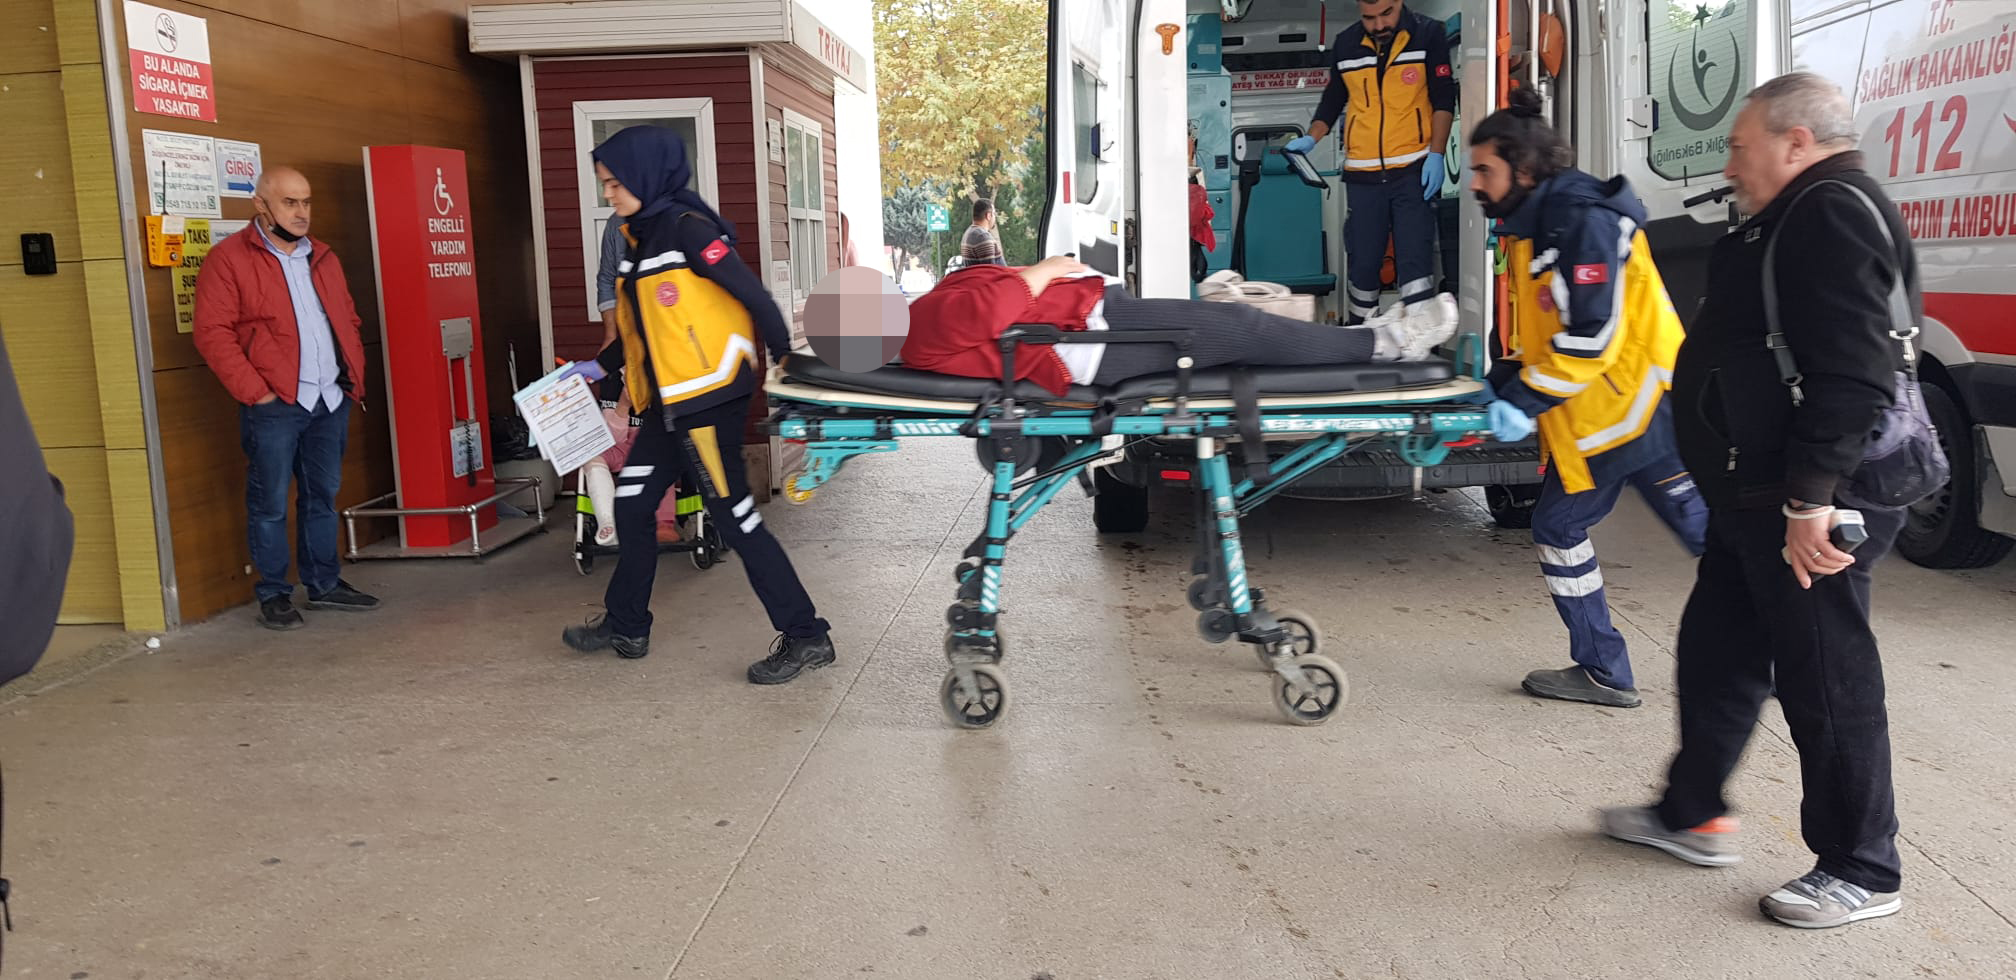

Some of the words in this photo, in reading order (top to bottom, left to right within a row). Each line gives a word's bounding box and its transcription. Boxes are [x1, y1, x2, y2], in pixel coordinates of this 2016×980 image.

[1928, 0, 1955, 36] T.C.
[144, 55, 158, 71] BU
[160, 61, 200, 78] ALANDA
[1859, 56, 1916, 103] SAĞLIK
[1916, 23, 2016, 91] BAKANLIĞI
[139, 72, 177, 95] SİGARA
[178, 78, 208, 100] İÇMEK
[1255, 80, 1266, 88] VE
[152, 97, 200, 117] YASAKTIR
[1884, 95, 1968, 178] 112
[225, 156, 255, 179] GİRİŞ
[428, 215, 464, 233] ENGELLİ
[431, 240, 466, 255] YARDIM
[428, 262, 472, 278] TELEFONU
